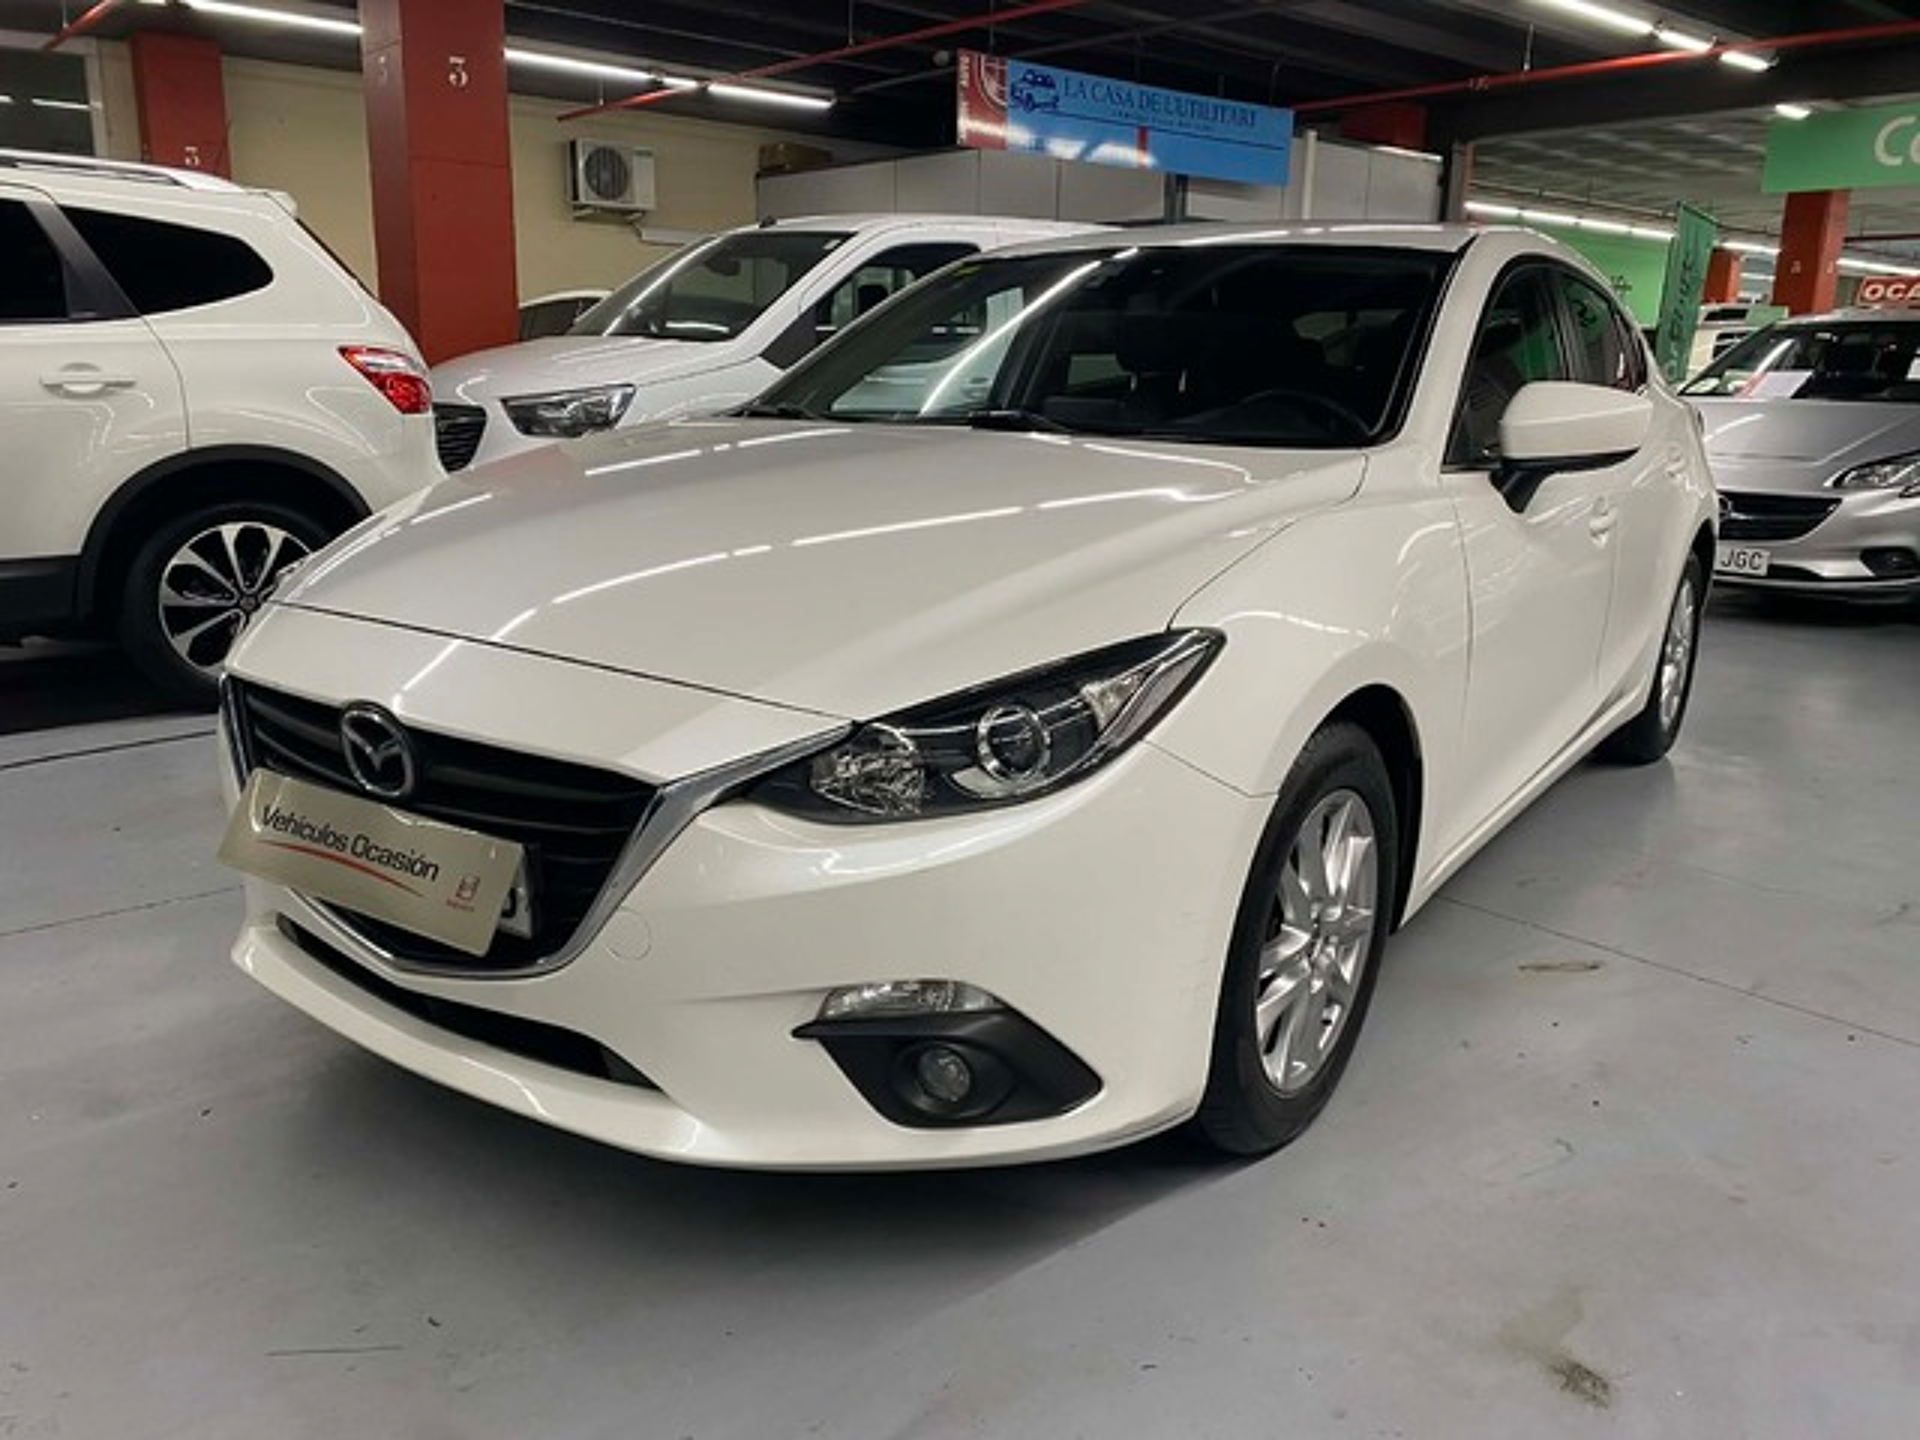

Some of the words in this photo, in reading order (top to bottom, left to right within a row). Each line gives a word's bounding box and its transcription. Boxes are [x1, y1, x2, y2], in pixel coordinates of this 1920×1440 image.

[1064, 76, 1087, 100] LA
[1091, 82, 1135, 109] CASA
[1139, 90, 1161, 112] DE
[1721, 550, 1763, 570] JGC
[351, 832, 440, 882] Ocasión
